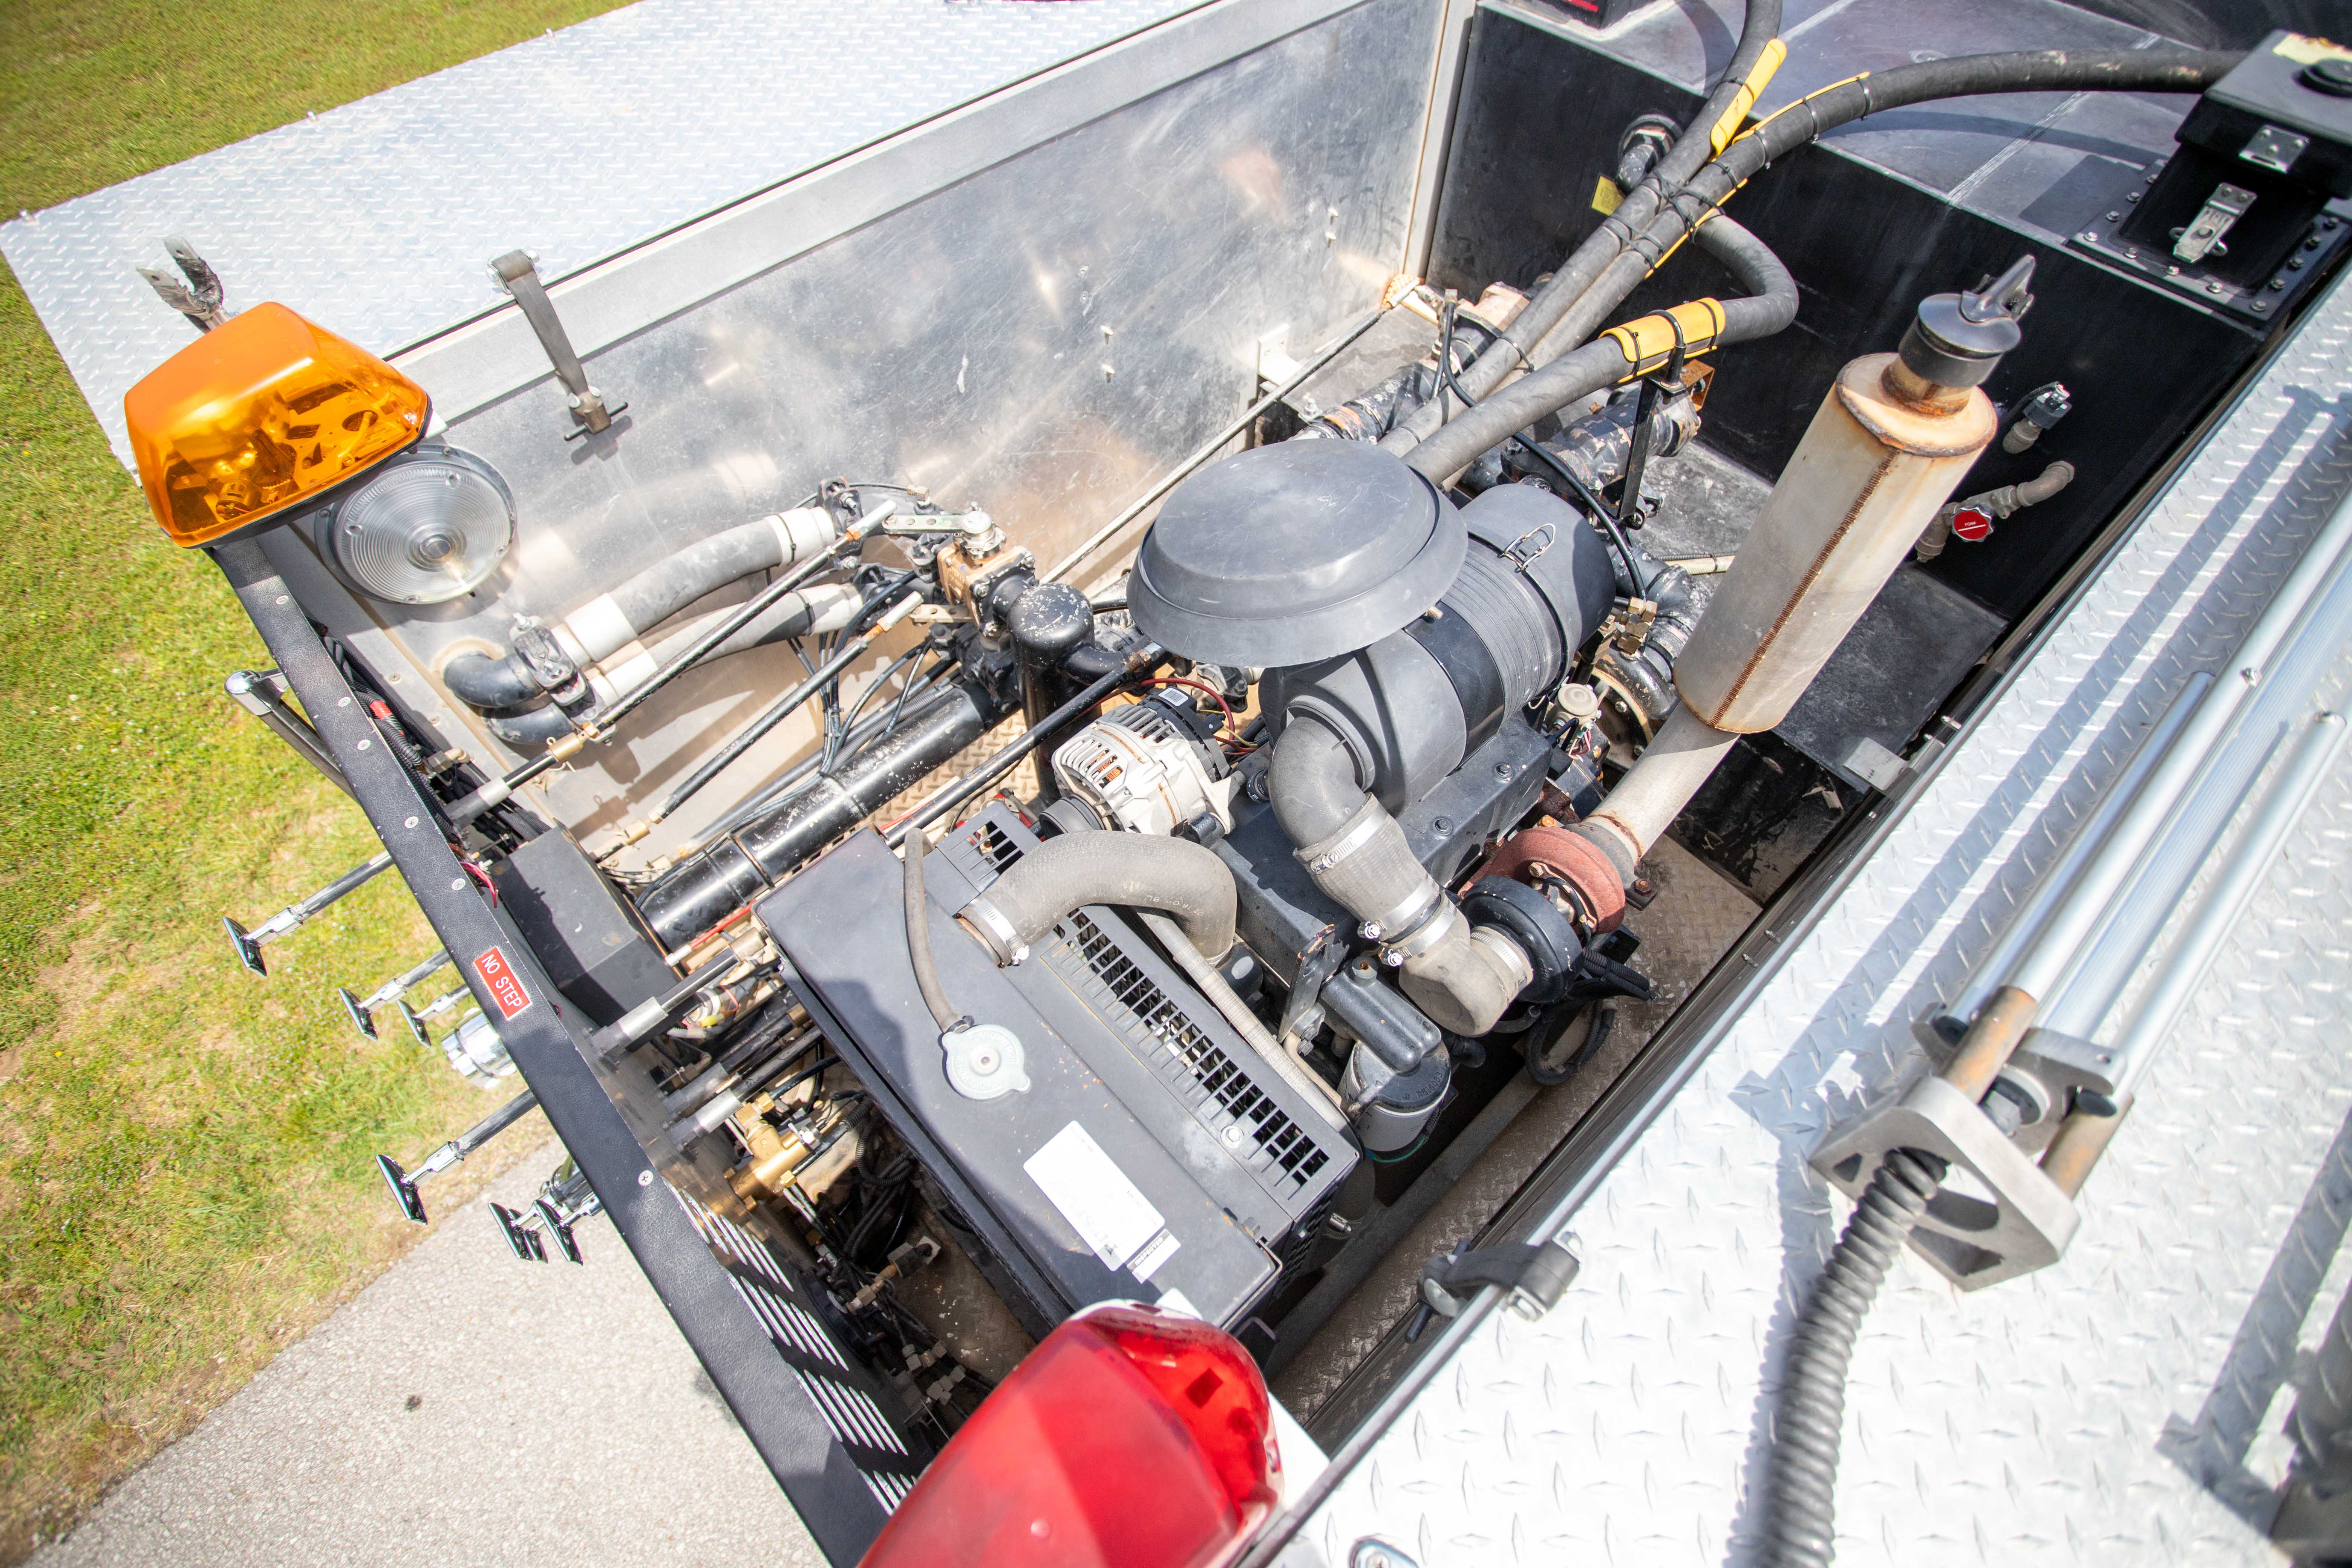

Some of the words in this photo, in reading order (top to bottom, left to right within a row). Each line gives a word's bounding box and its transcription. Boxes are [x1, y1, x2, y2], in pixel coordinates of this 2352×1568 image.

[481, 954, 501, 974] NO
[495, 976, 522, 1007] STEP
[1266, 1054, 1286, 1076] DEERE
[1269, 1050, 1290, 1073] DEERE
[1274, 1045, 1295, 1069] DEERE
[1285, 1075, 1302, 1093] JOHN
[1289, 1072, 1306, 1090] JOHN
[1293, 1067, 1309, 1086] JOHN
[1134, 1237, 1164, 1266] INSPECTED
